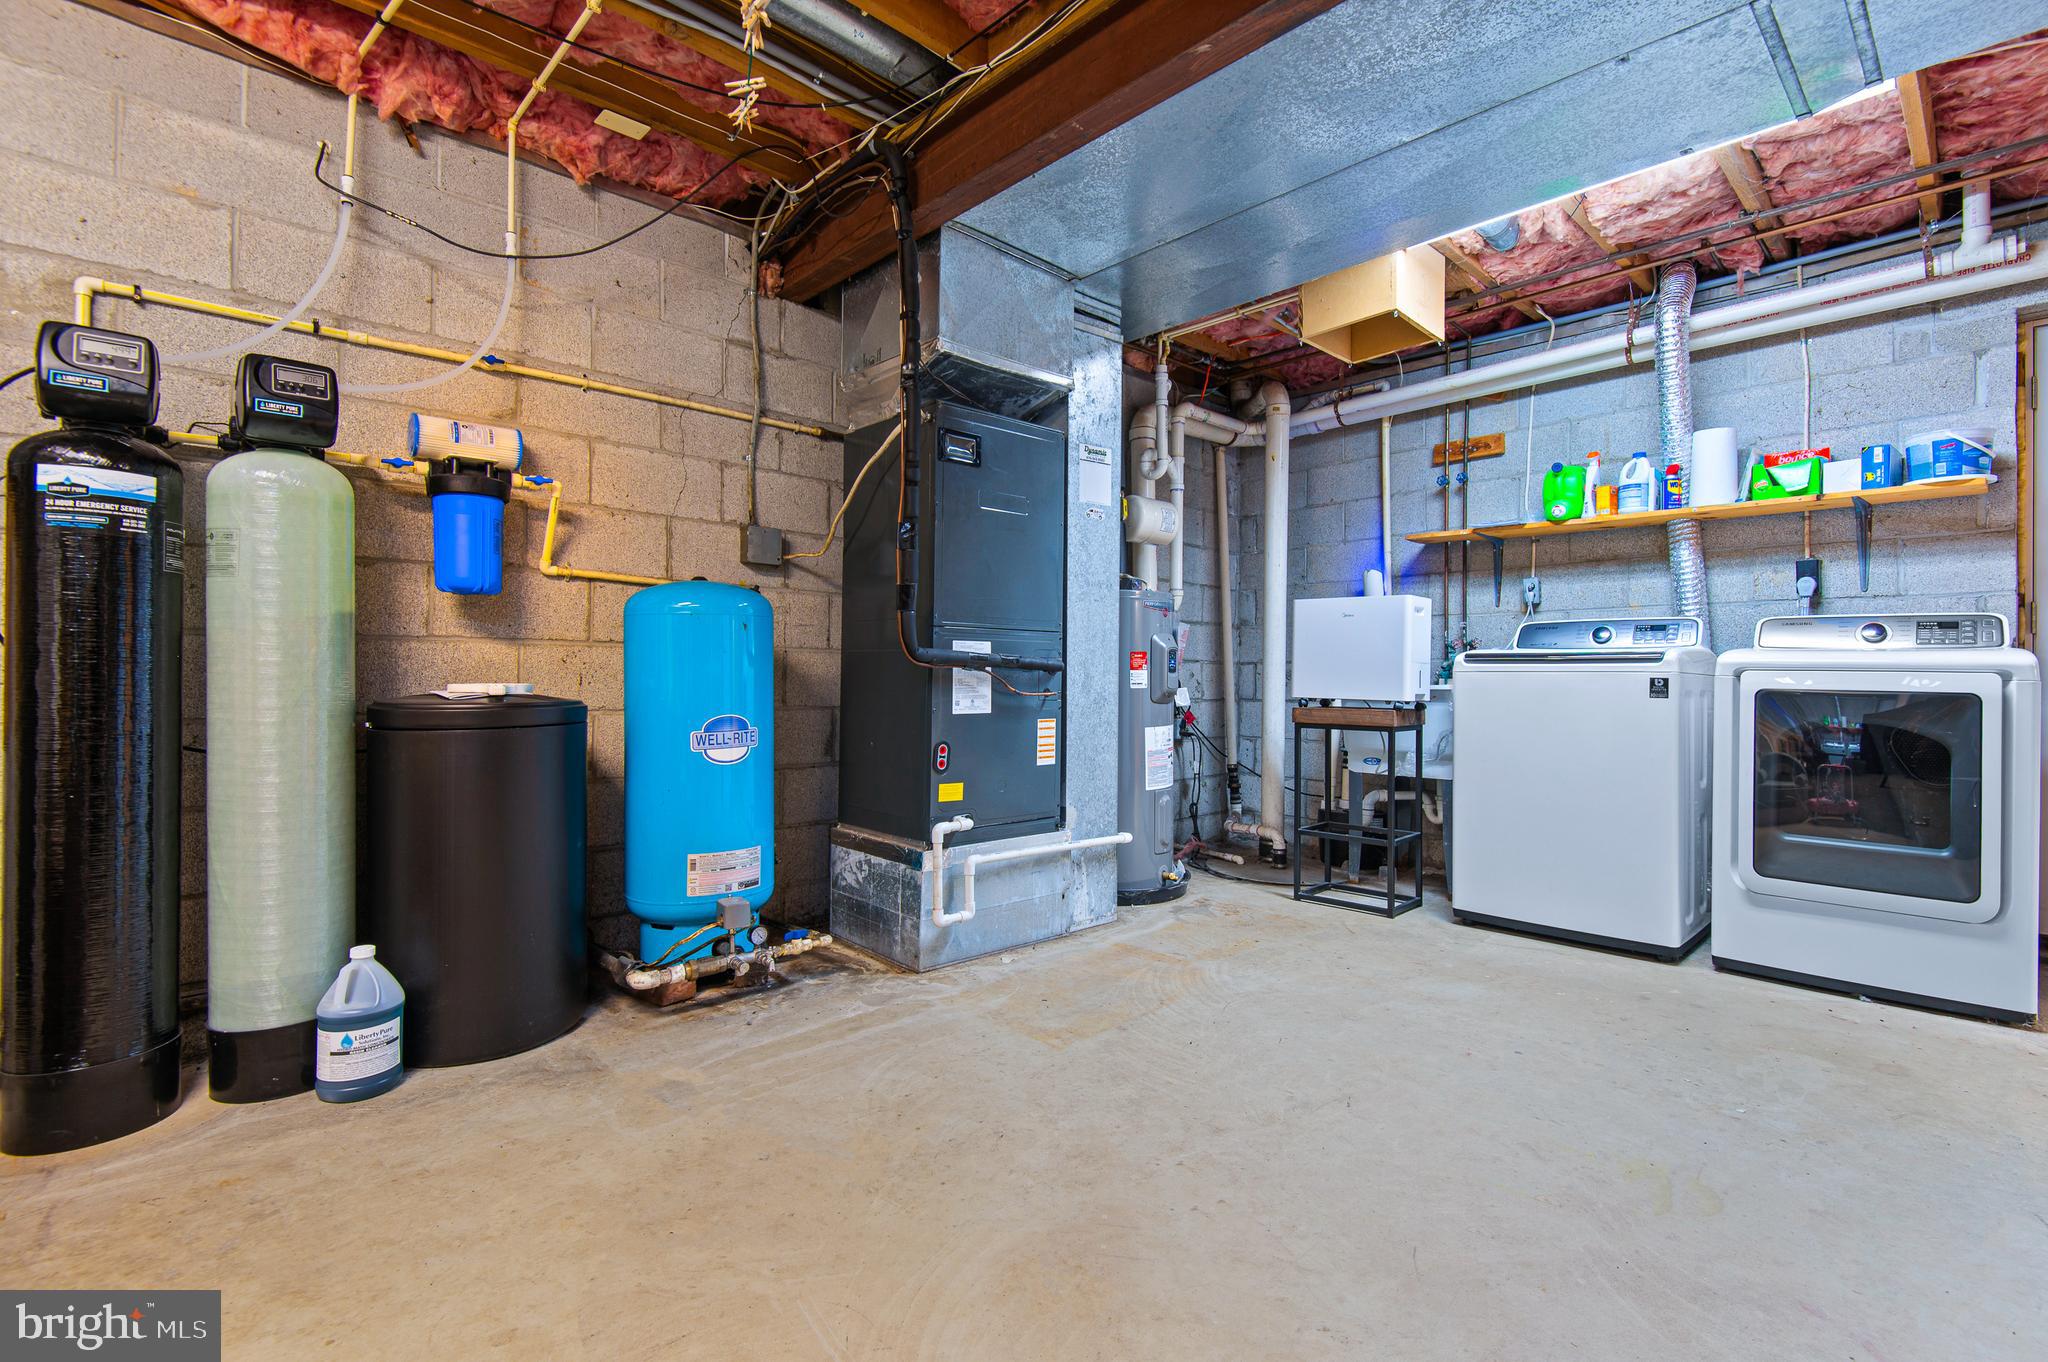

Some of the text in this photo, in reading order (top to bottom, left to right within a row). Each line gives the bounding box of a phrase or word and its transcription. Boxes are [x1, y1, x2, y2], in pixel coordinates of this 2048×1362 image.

[265, 402, 285, 410] LIBERTY
[44, 498, 54, 506] 24
[54, 499, 75, 507] HOUR
[75, 500, 119, 510] EMERGENCY
[120, 504, 148, 514] SERVICE
[354, 1026, 393, 1041] Liberty Pure
